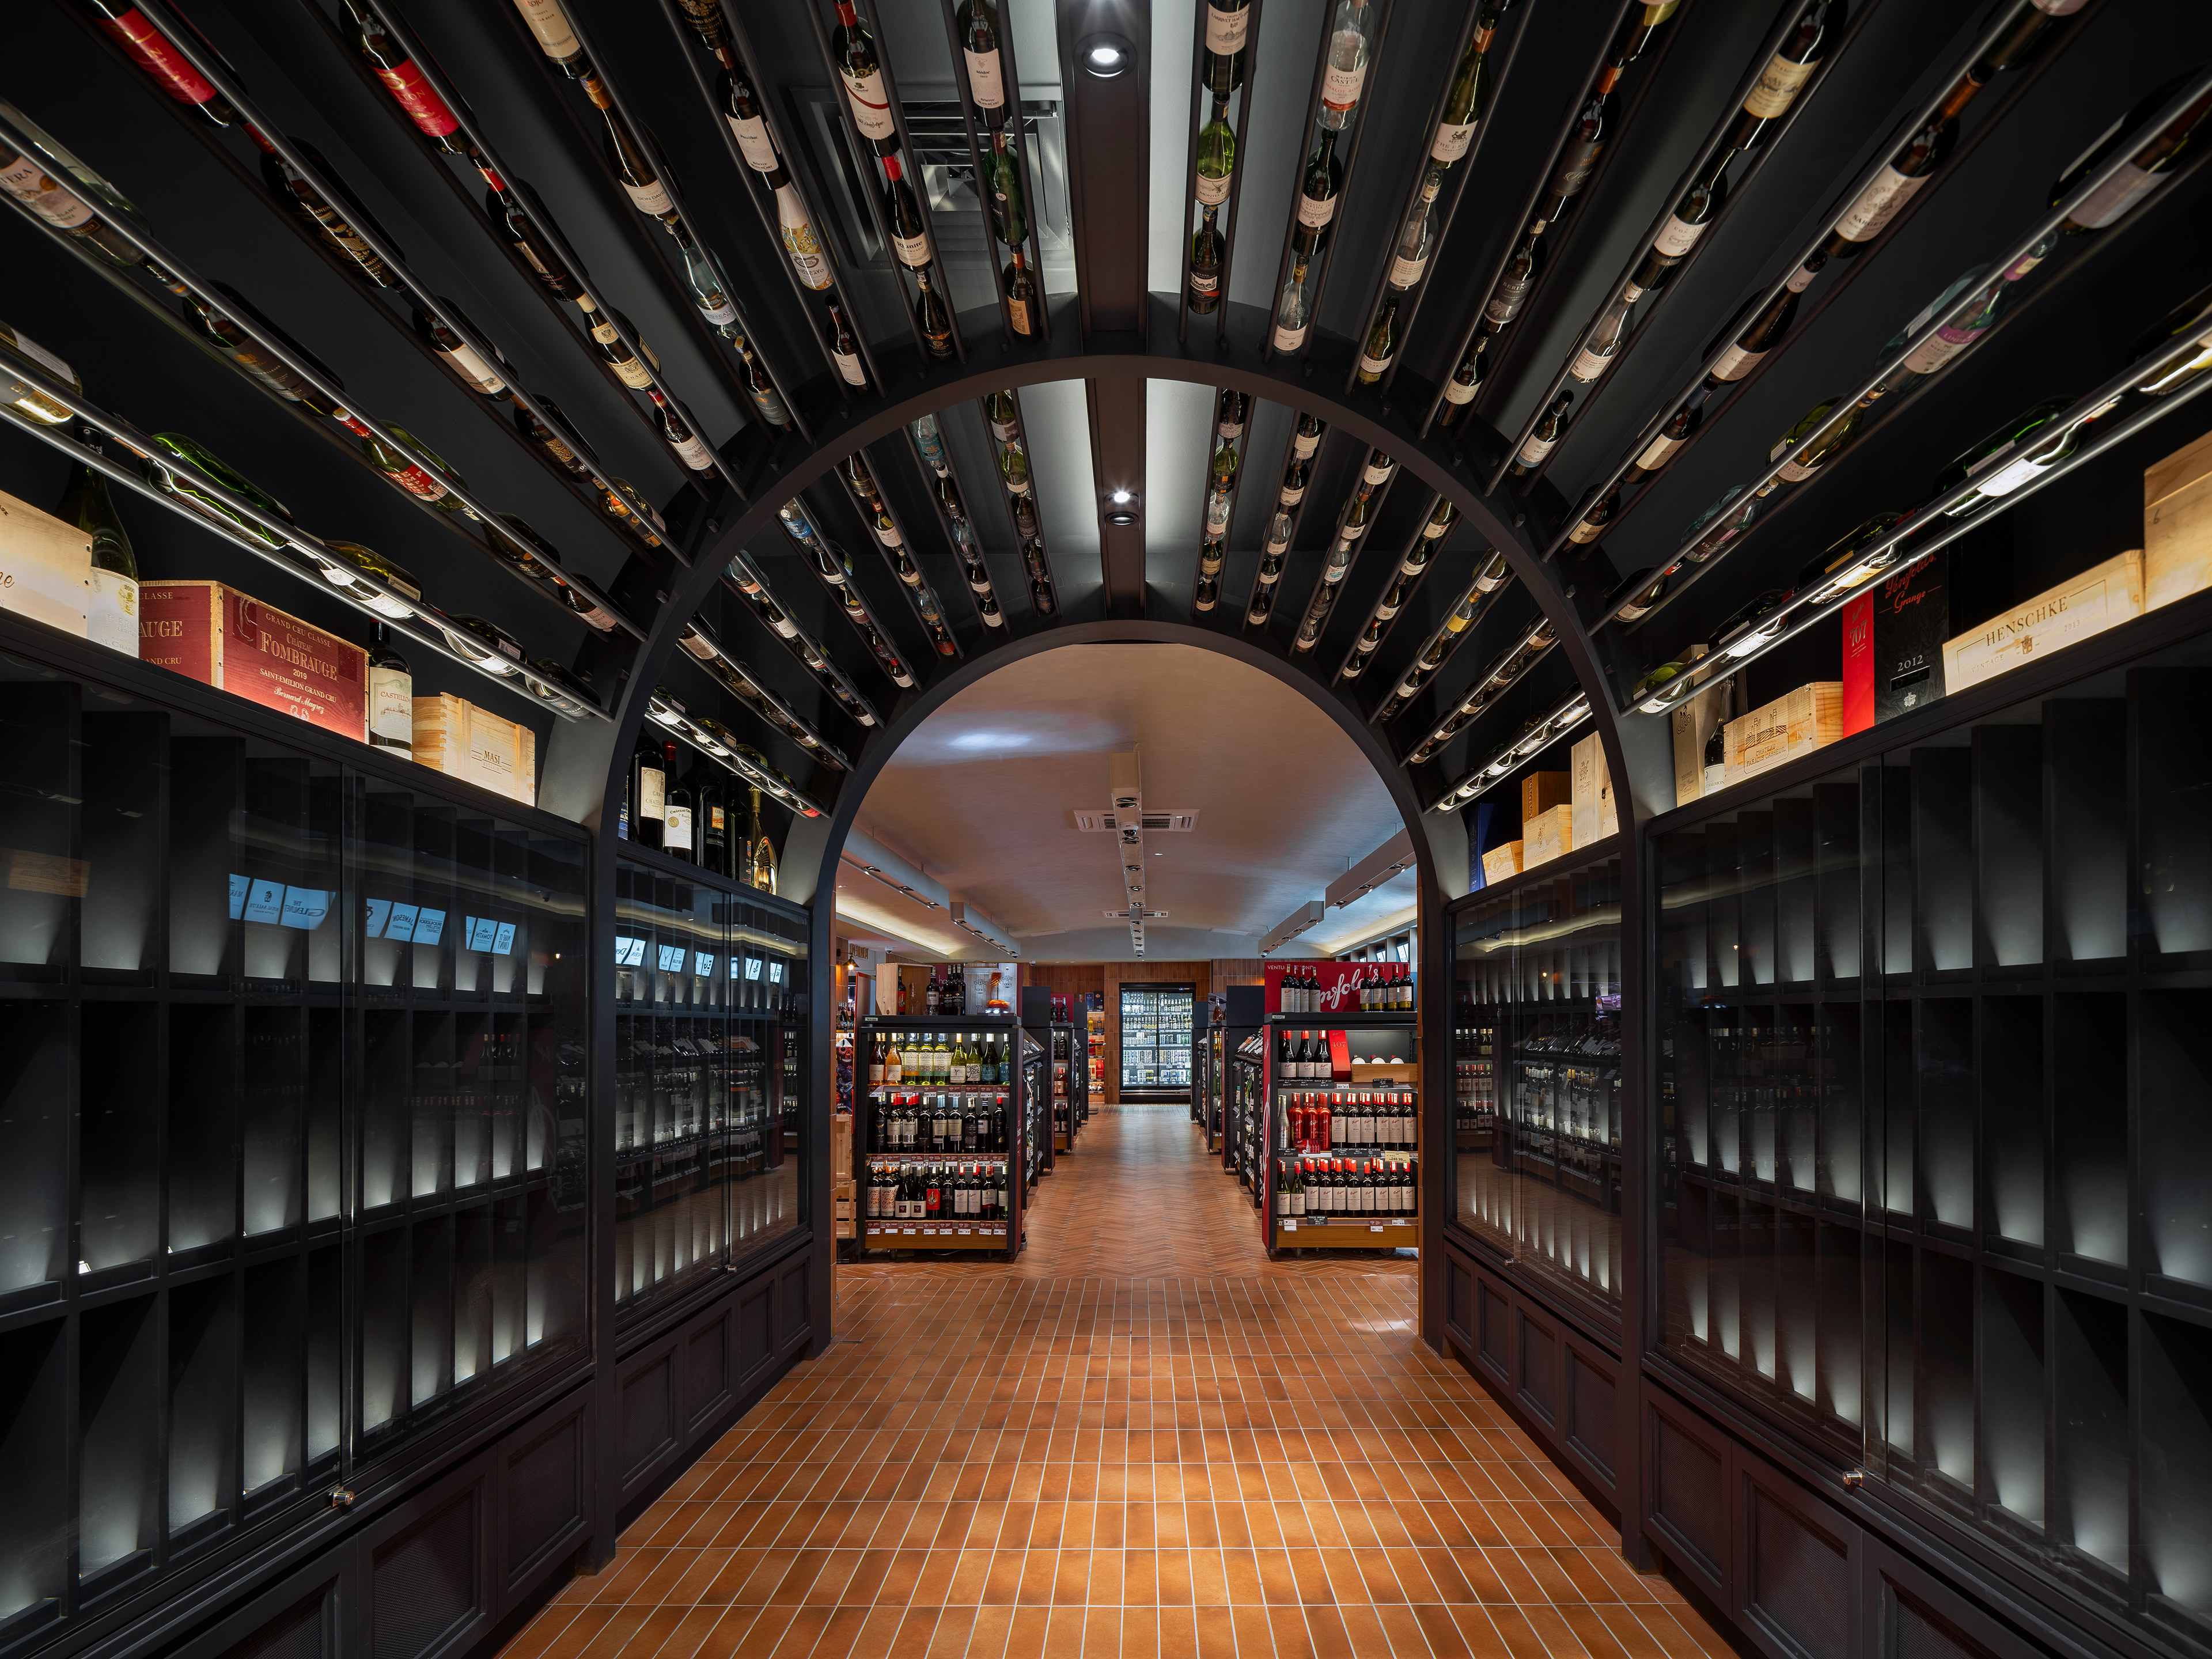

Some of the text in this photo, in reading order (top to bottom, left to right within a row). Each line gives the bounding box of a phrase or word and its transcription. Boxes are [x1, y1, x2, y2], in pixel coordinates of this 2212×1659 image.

[685, 16, 704, 24] GRAND
[1331, 75, 1359, 84] CASTEL
[1325, 82, 1345, 93] MERLOT
[1436, 139, 1449, 149] THE
[896, 240, 923, 249] Riunite
[124, 585, 135, 593] 2000
[139, 592, 173, 600] CLASSE
[1893, 590, 1926, 613] Grange
[266, 613, 290, 629] GRAND
[292, 625, 306, 636] CRU
[1986, 596, 2068, 647] HENSCHKE
[2063, 619, 2081, 633] 2013
[1850, 619, 1868, 647] 707
[260, 630, 337, 681] FOMBRAUGE
[1897, 654, 1924, 672] 2012
[1971, 654, 2004, 673] VINTAGE
[293, 669, 307, 680] 2019
[260, 668, 336, 703] SAINT-EMILION GRAND CRU
[274, 686, 325, 714] Bernard Magrez
[380, 691, 409, 702] CASTELLO
[484, 750, 500, 764] MASI
[1746, 747, 1786, 767] PARADIS CASSEUIL
[1755, 744, 1776, 756] CHATEAU
